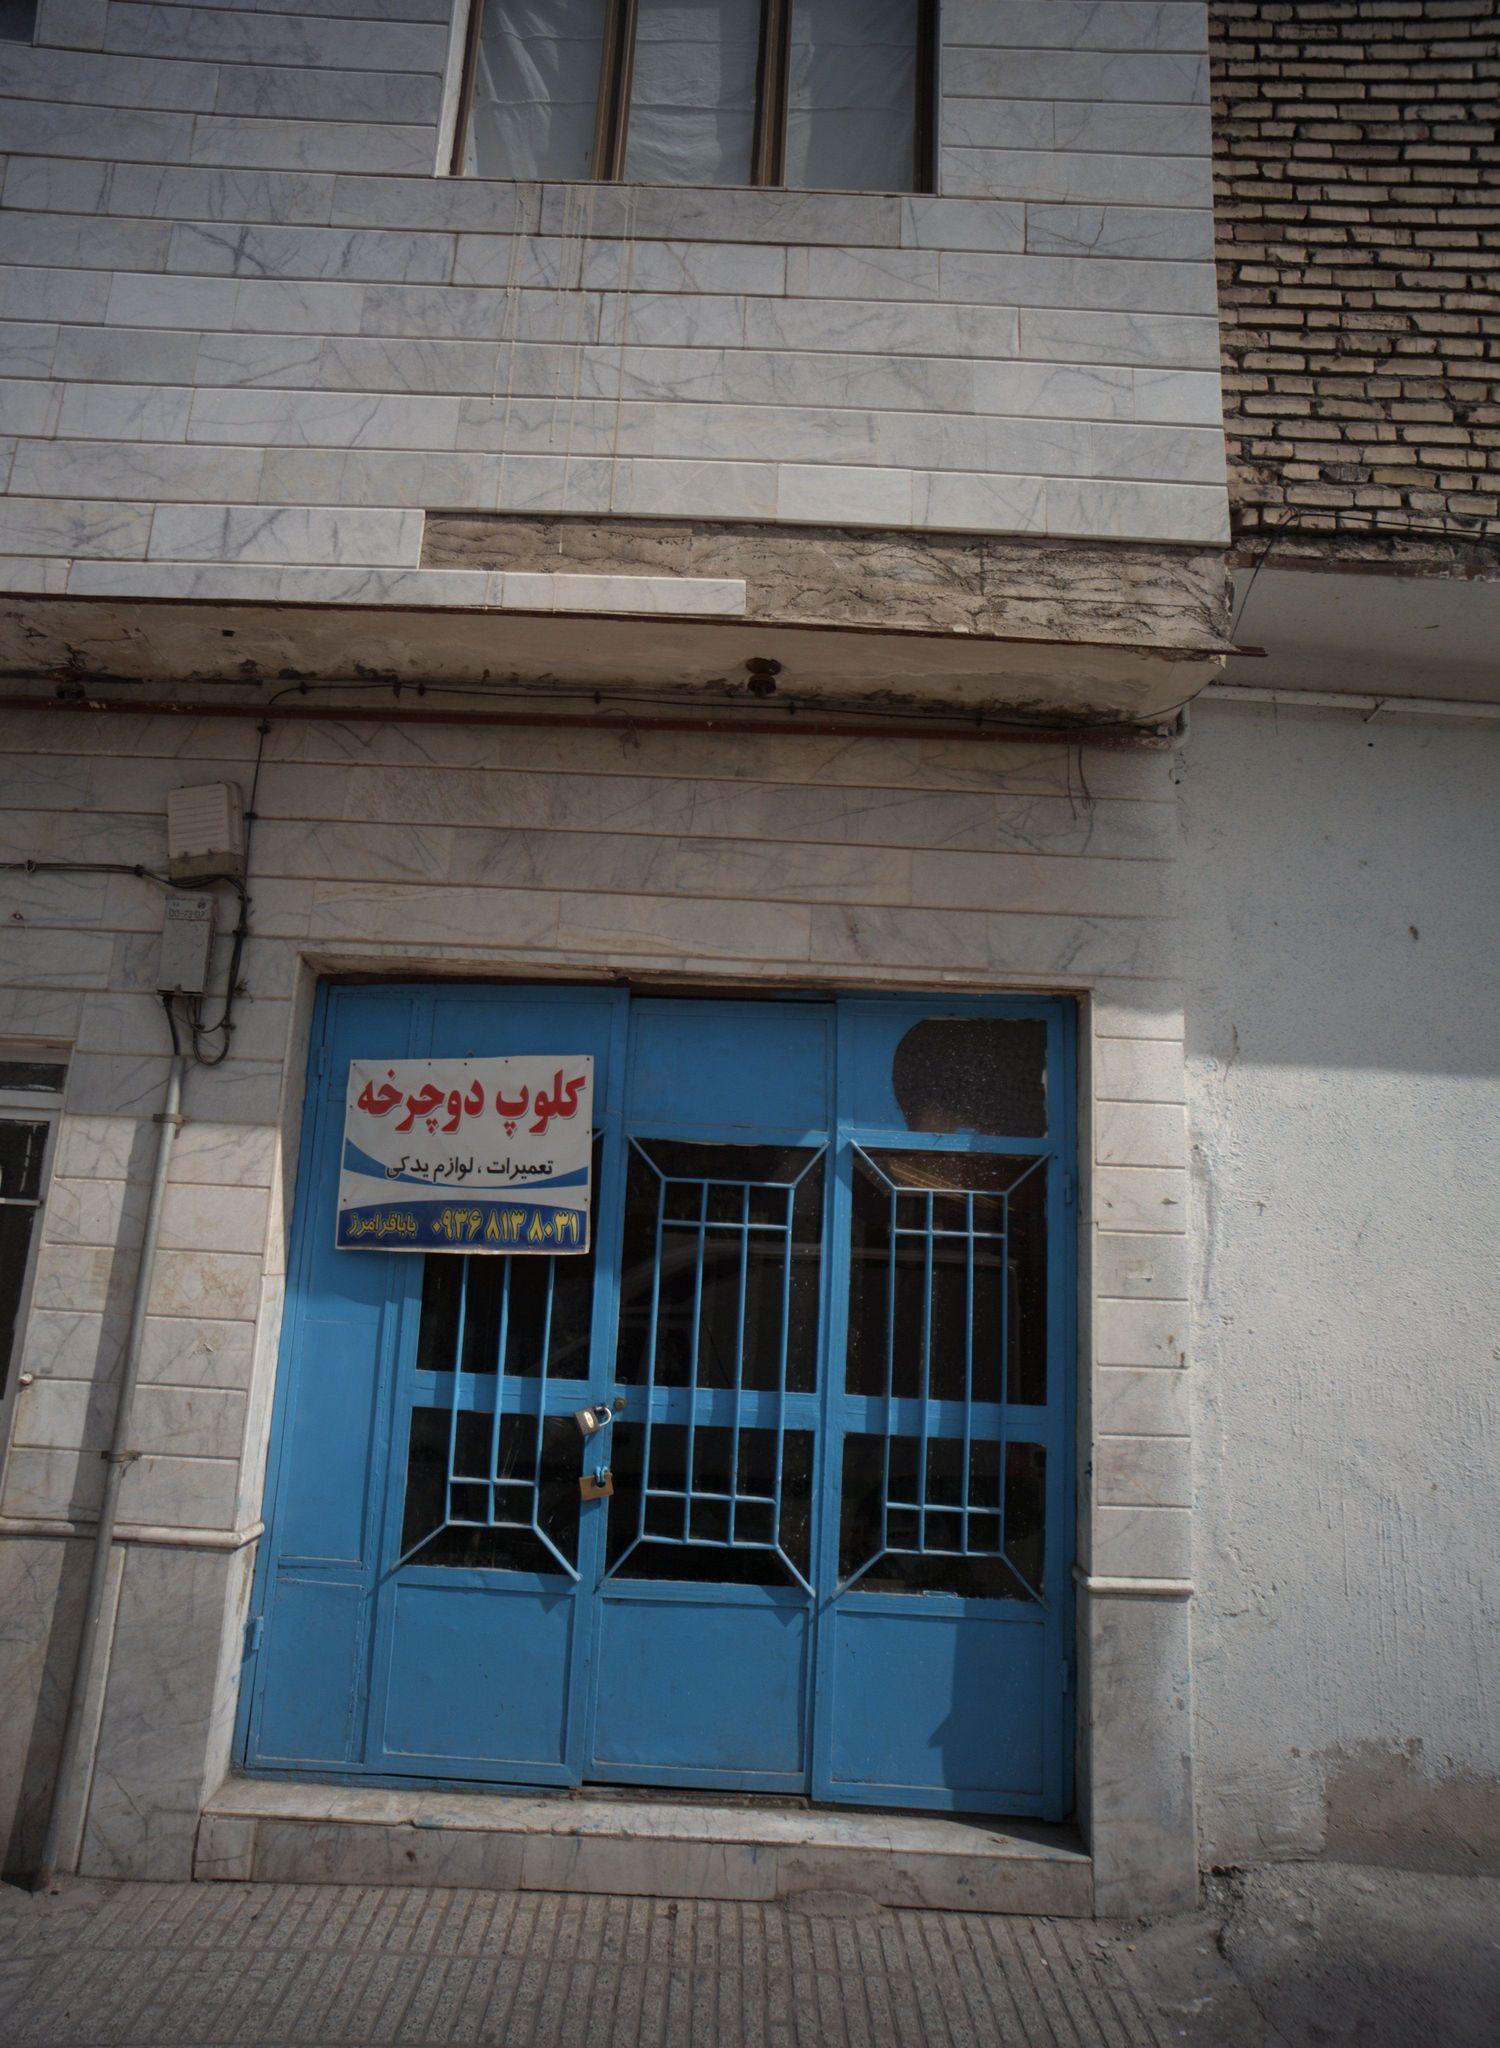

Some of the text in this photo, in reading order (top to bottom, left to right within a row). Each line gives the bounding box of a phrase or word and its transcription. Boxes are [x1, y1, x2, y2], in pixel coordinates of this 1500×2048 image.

[357, 1068, 587, 1137] کلوپ دوچرخه
[386, 1156, 429, 1179] یدکی
[433, 1156, 474, 1183] لوازم
